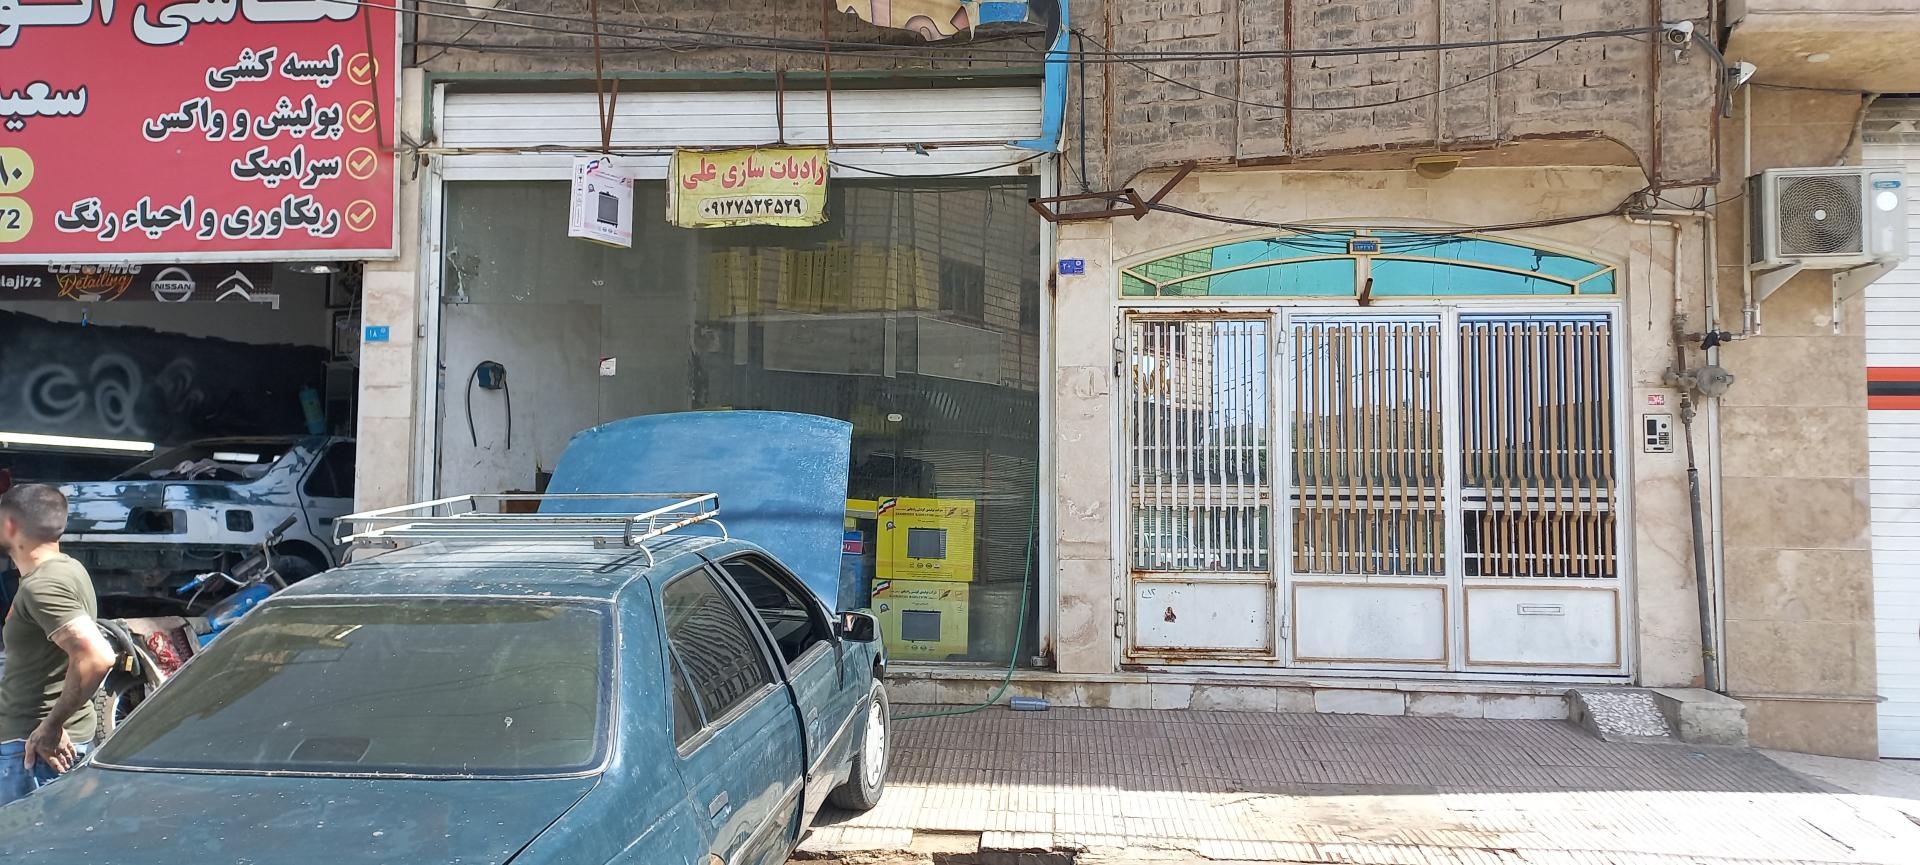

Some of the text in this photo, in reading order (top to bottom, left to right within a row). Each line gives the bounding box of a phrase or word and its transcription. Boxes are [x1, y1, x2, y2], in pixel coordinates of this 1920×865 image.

[207, 47, 341, 88] لیسه کشی
[145, 96, 341, 139] پولیش و واکس
[232, 146, 339, 186] سرامیک
[682, 155, 825, 190] رادیات سازی علی
[57, 196, 338, 239] ریکاوری و احیاء رنگ
[704, 198, 802, 216] ۰۹۱۲۷۵۲۴۵۲۹
[57, 272, 130, 297] Detailing
[154, 282, 191, 290] NISSAN
